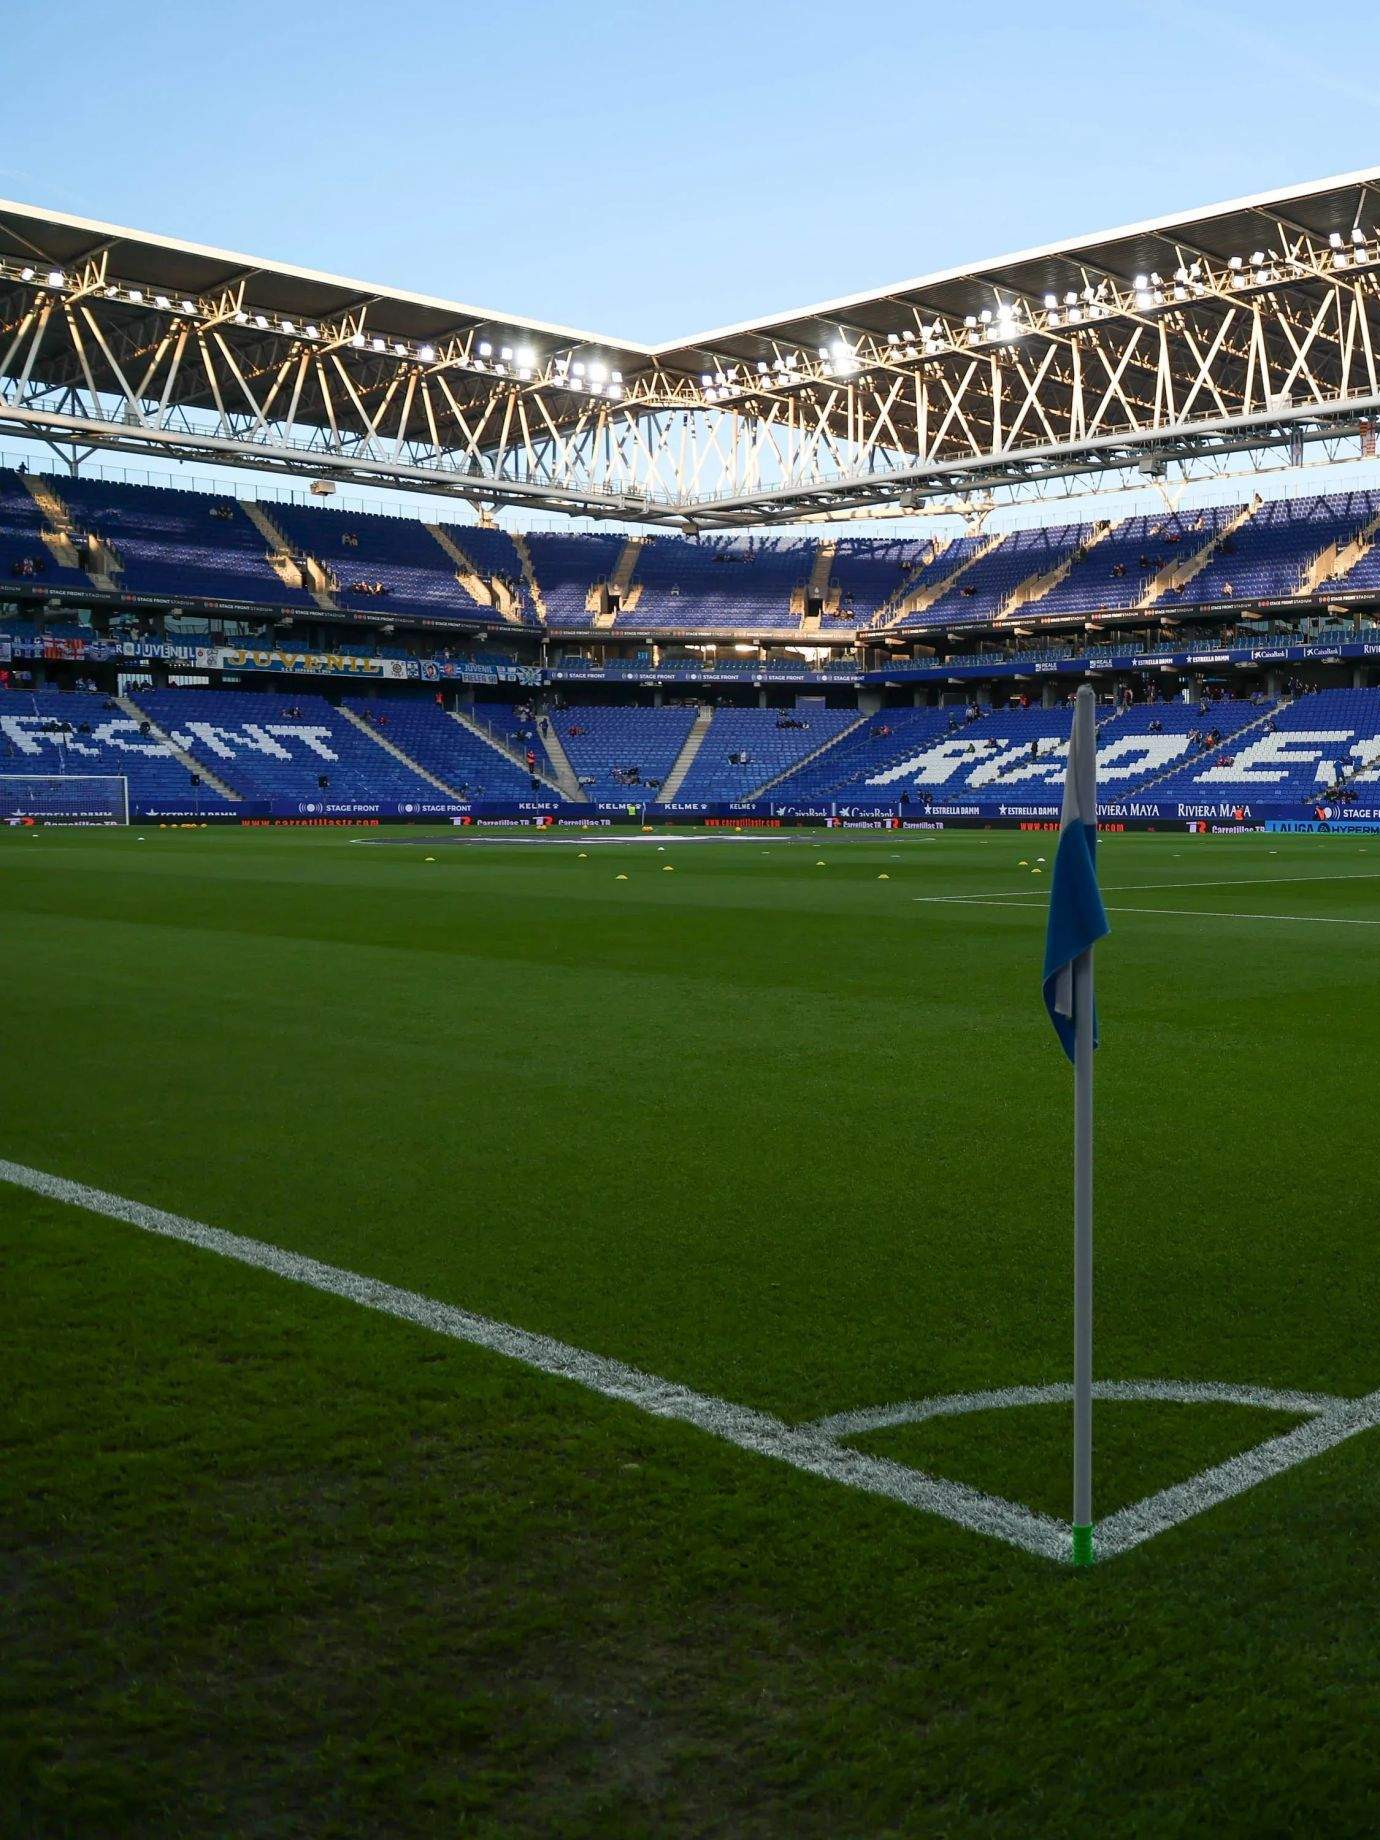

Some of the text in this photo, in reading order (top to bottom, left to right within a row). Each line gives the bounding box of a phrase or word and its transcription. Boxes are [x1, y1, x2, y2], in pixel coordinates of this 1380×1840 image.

[227, 650, 380, 673] JUVENIL
[326, 804, 379, 812] STAGE FRONT
[422, 804, 472, 812] STAGE FRONT
[1008, 807, 1058, 815] ESTRELLA DAMM
[1130, 803, 1159, 816] MAYA
[1343, 810, 1371, 818] STAGE
